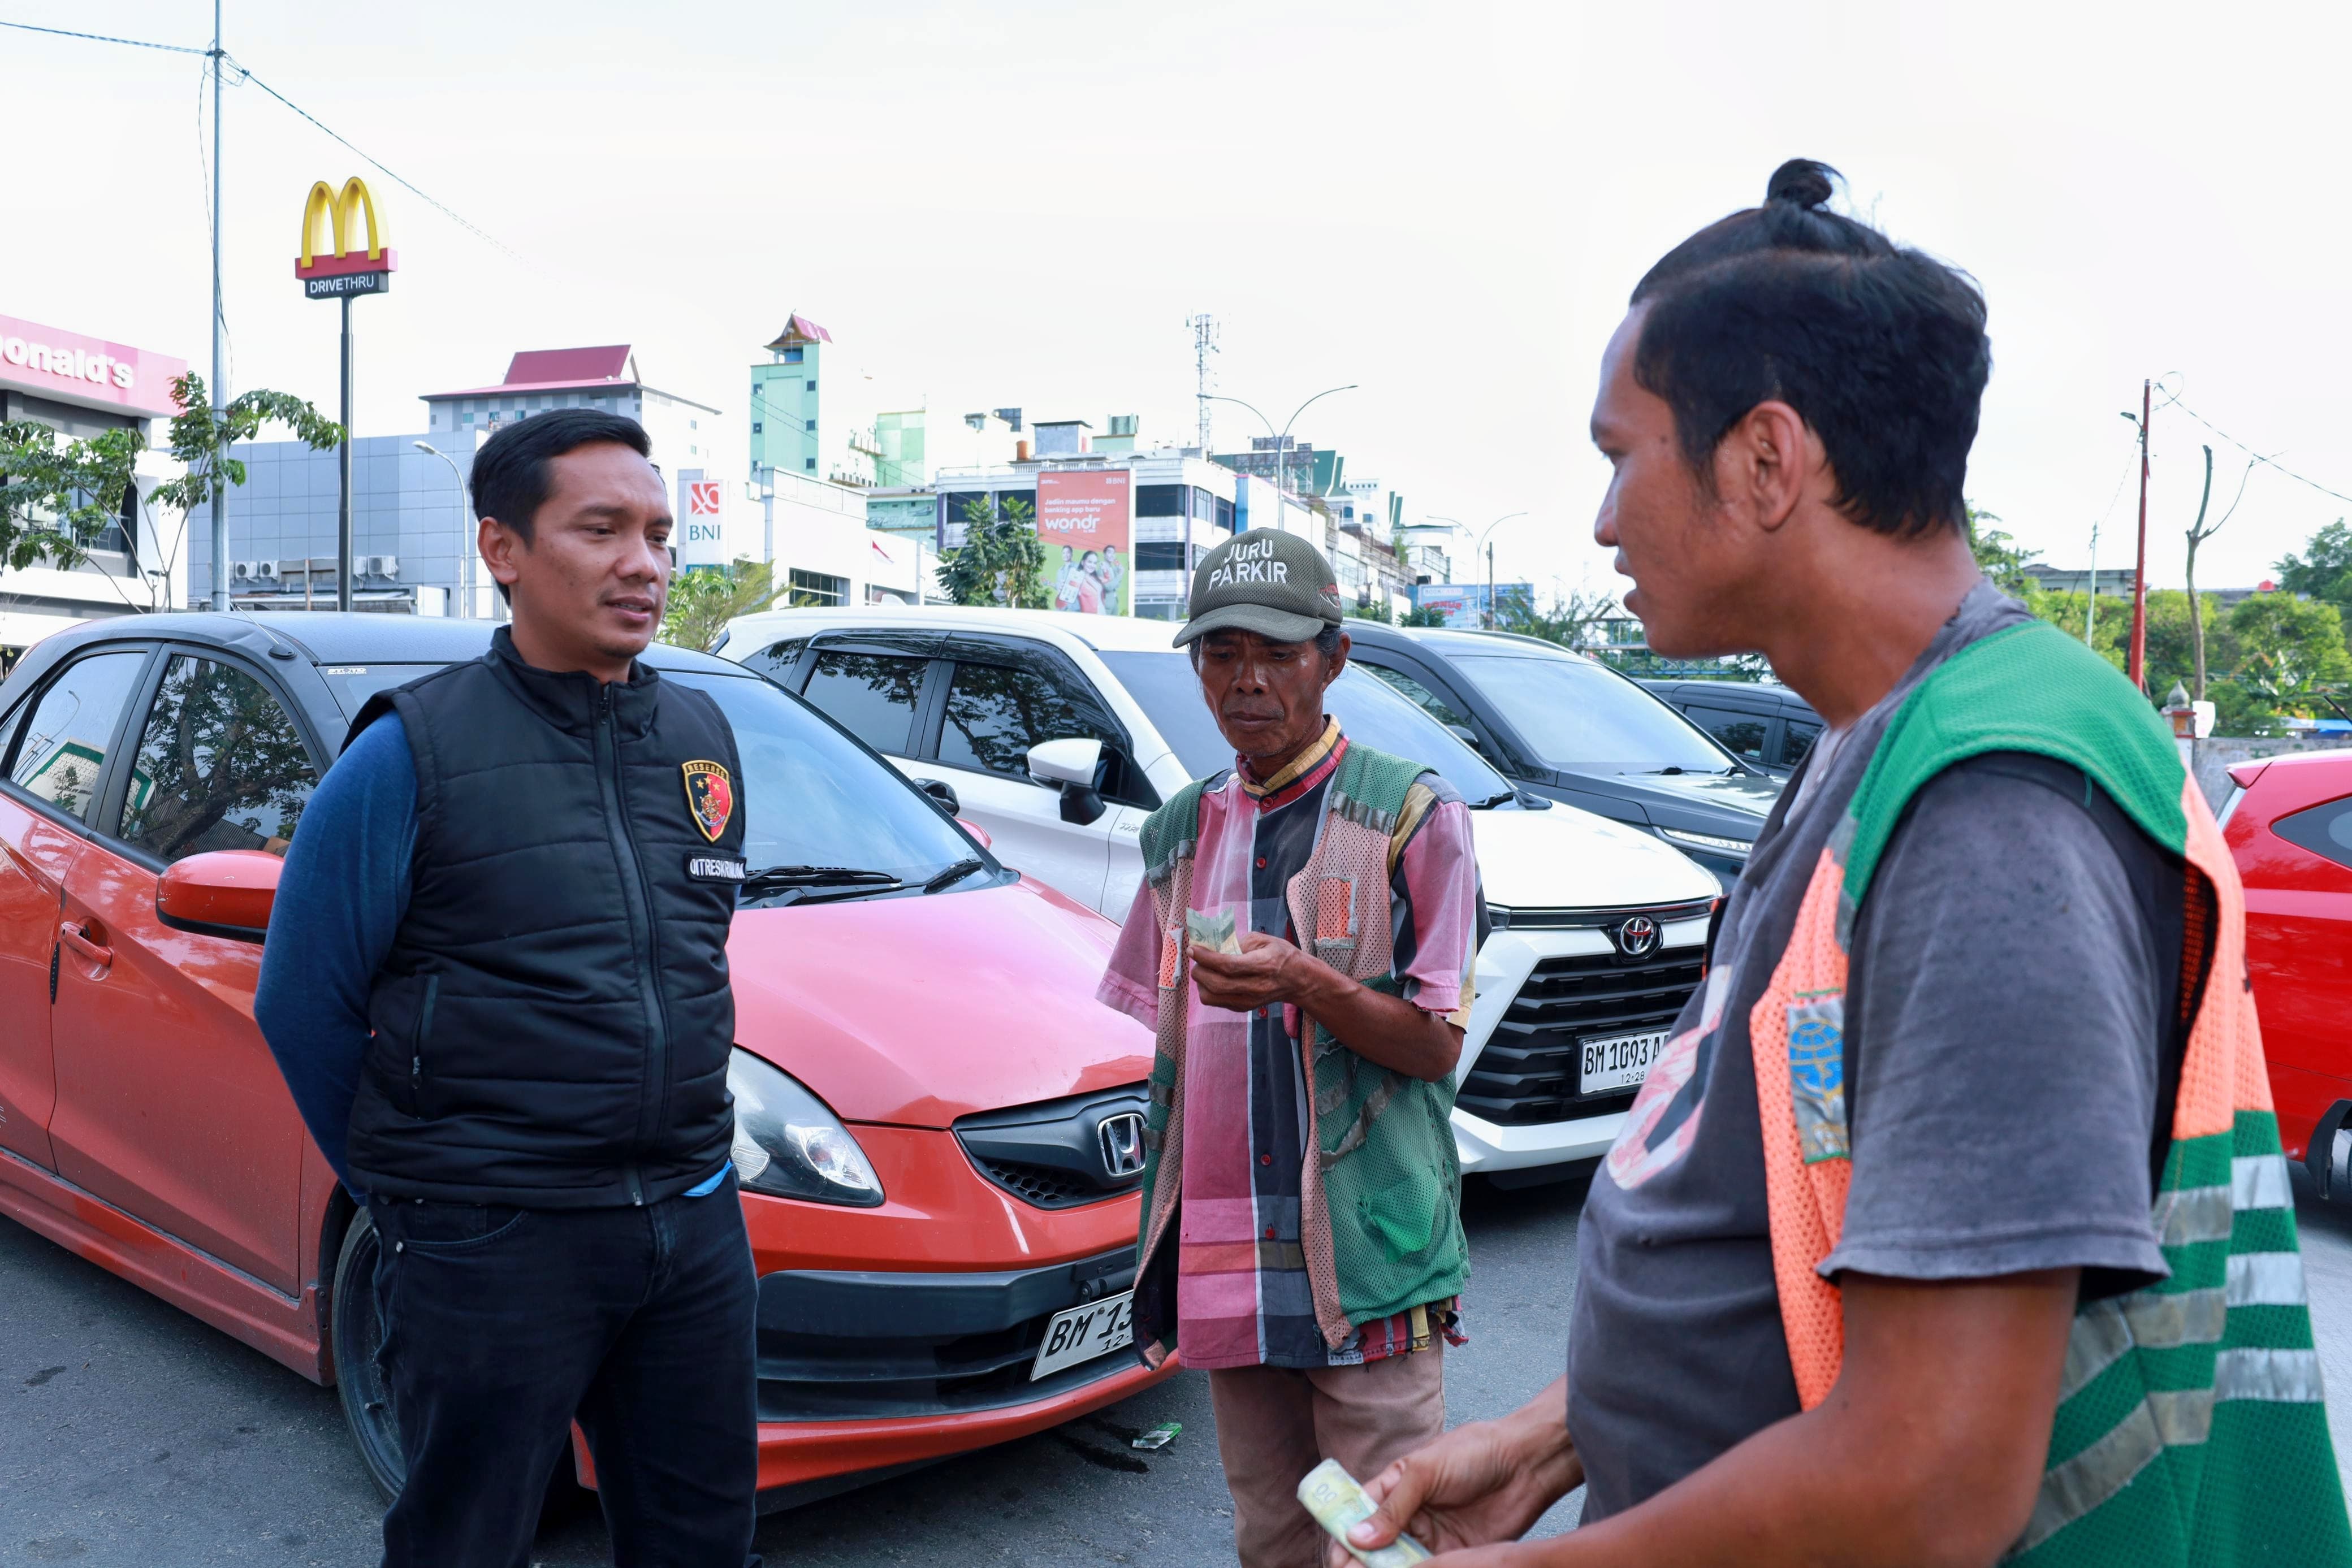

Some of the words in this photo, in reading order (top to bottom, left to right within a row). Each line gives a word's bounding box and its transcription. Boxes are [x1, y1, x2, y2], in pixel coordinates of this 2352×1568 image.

[0, 335, 134, 389] onald's
[689, 525, 720, 540] BNI
[1045, 514, 1100, 530] wondr
[1223, 538, 1273, 564] JURU
[1207, 560, 1287, 592] PARKIR
[1584, 1045, 1605, 1075] BM
[1609, 1038, 1648, 1071] 1093
[1045, 1311, 1095, 1357] BM
